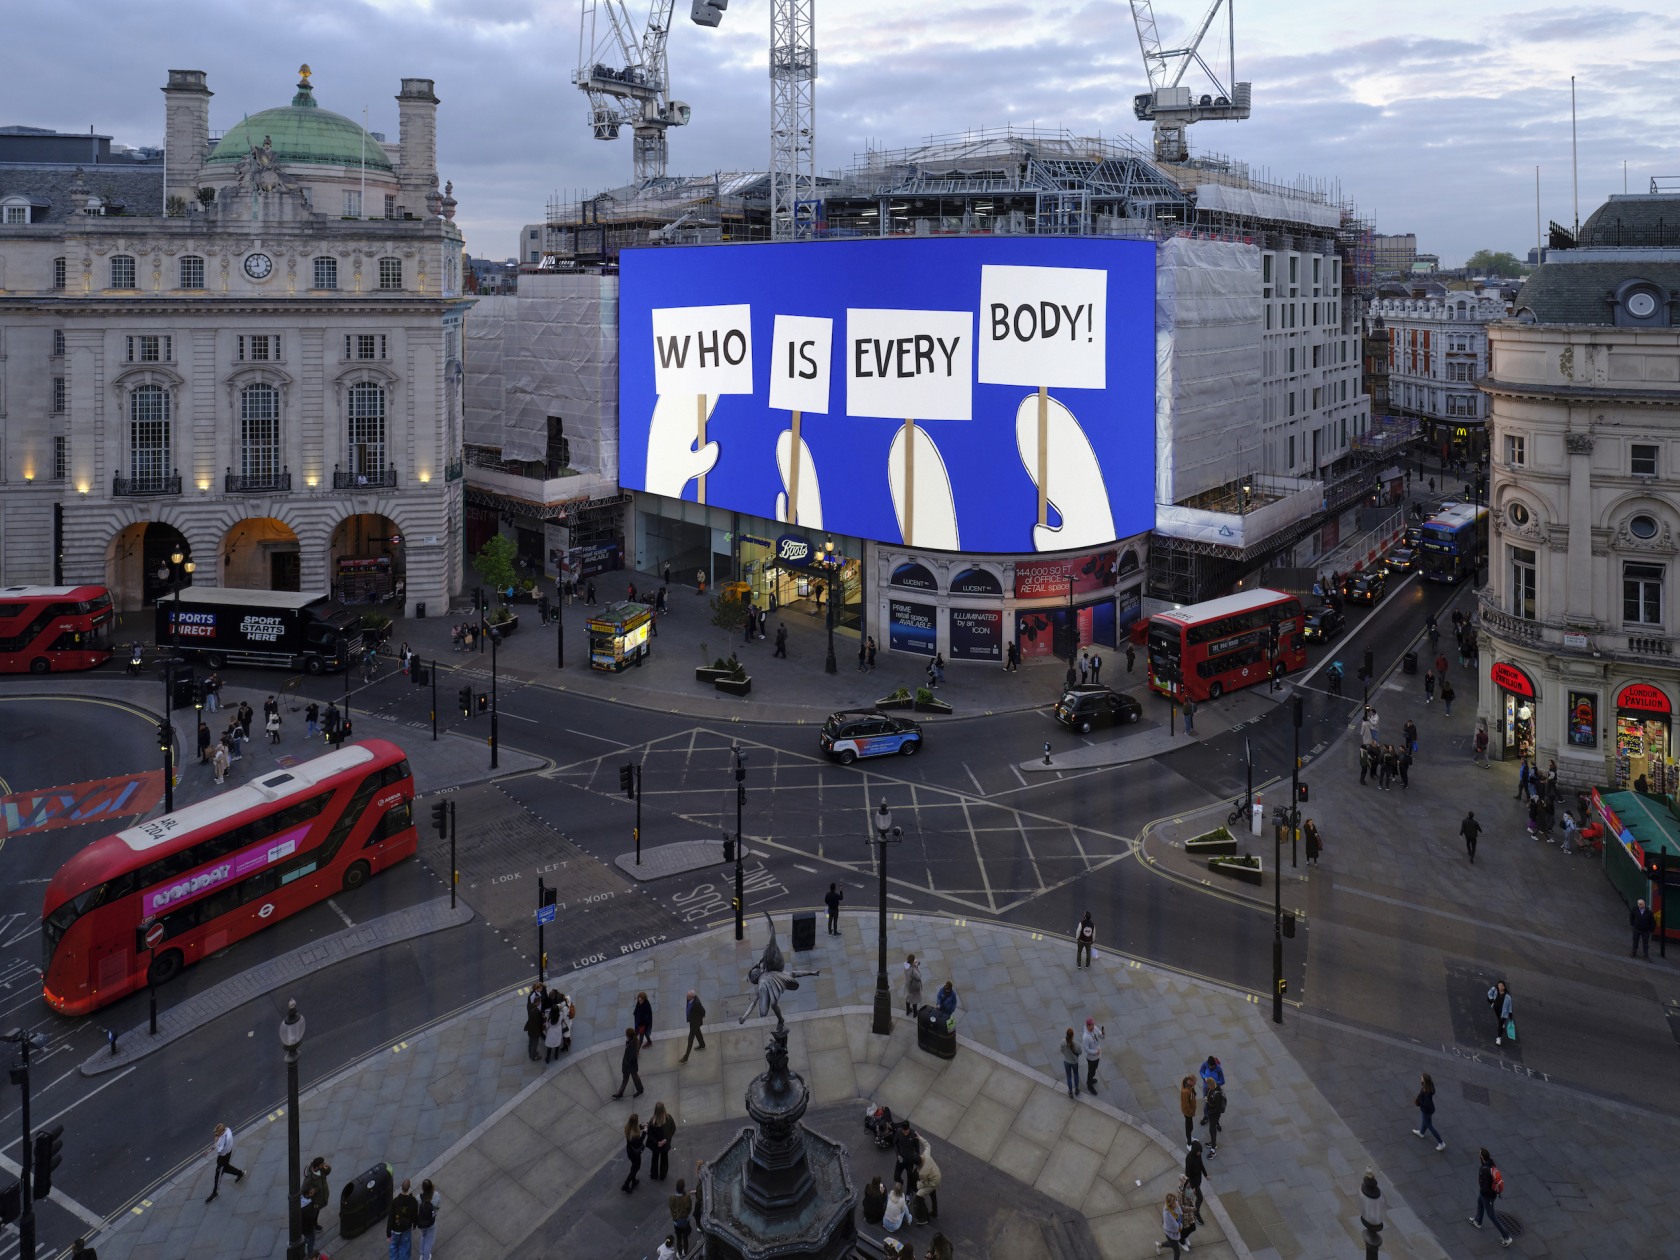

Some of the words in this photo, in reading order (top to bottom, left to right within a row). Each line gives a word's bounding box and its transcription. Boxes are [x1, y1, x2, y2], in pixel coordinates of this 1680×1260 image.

[657, 328, 747, 369] WHO
[788, 340, 818, 380] IS
[855, 333, 961, 379] EVERY
[990, 301, 1094, 344] BODY!
[779, 539, 808, 560] Boots
[1016, 568, 1048, 577] 144,000
[1063, 565, 1072, 573] FT
[1025, 576, 1032, 584] of
[1034, 575, 1062, 583] OFFICE
[1020, 584, 1047, 593] RETAIL
[1049, 583, 1070, 592] space
[893, 604, 912, 613] PRIME
[244, 616, 281, 624] SPORT
[910, 615, 928, 623] space
[954, 612, 998, 621] ILLUMINATED
[242, 624, 283, 633] STARTS
[899, 620, 932, 629] AVAILABLE
[247, 633, 277, 641] HERE
[1498, 665, 1518, 679] LONDON
[1496, 672, 1522, 690] PAVILION
[1630, 688, 1658, 698] LONDON
[1625, 696, 1663, 708] PAVILION
[158, 818, 179, 830] ARL
[492, 872, 522, 884] LOOK
[536, 861, 568, 874] LEFT
[721, 861, 789, 906] LANE
[583, 891, 615, 904] LOOK
[672, 884, 731, 922] BUS
[573, 952, 607, 969] LOOK
[621, 936, 658, 954] RIGHT
[1499, 1060, 1550, 1082] LEFT
